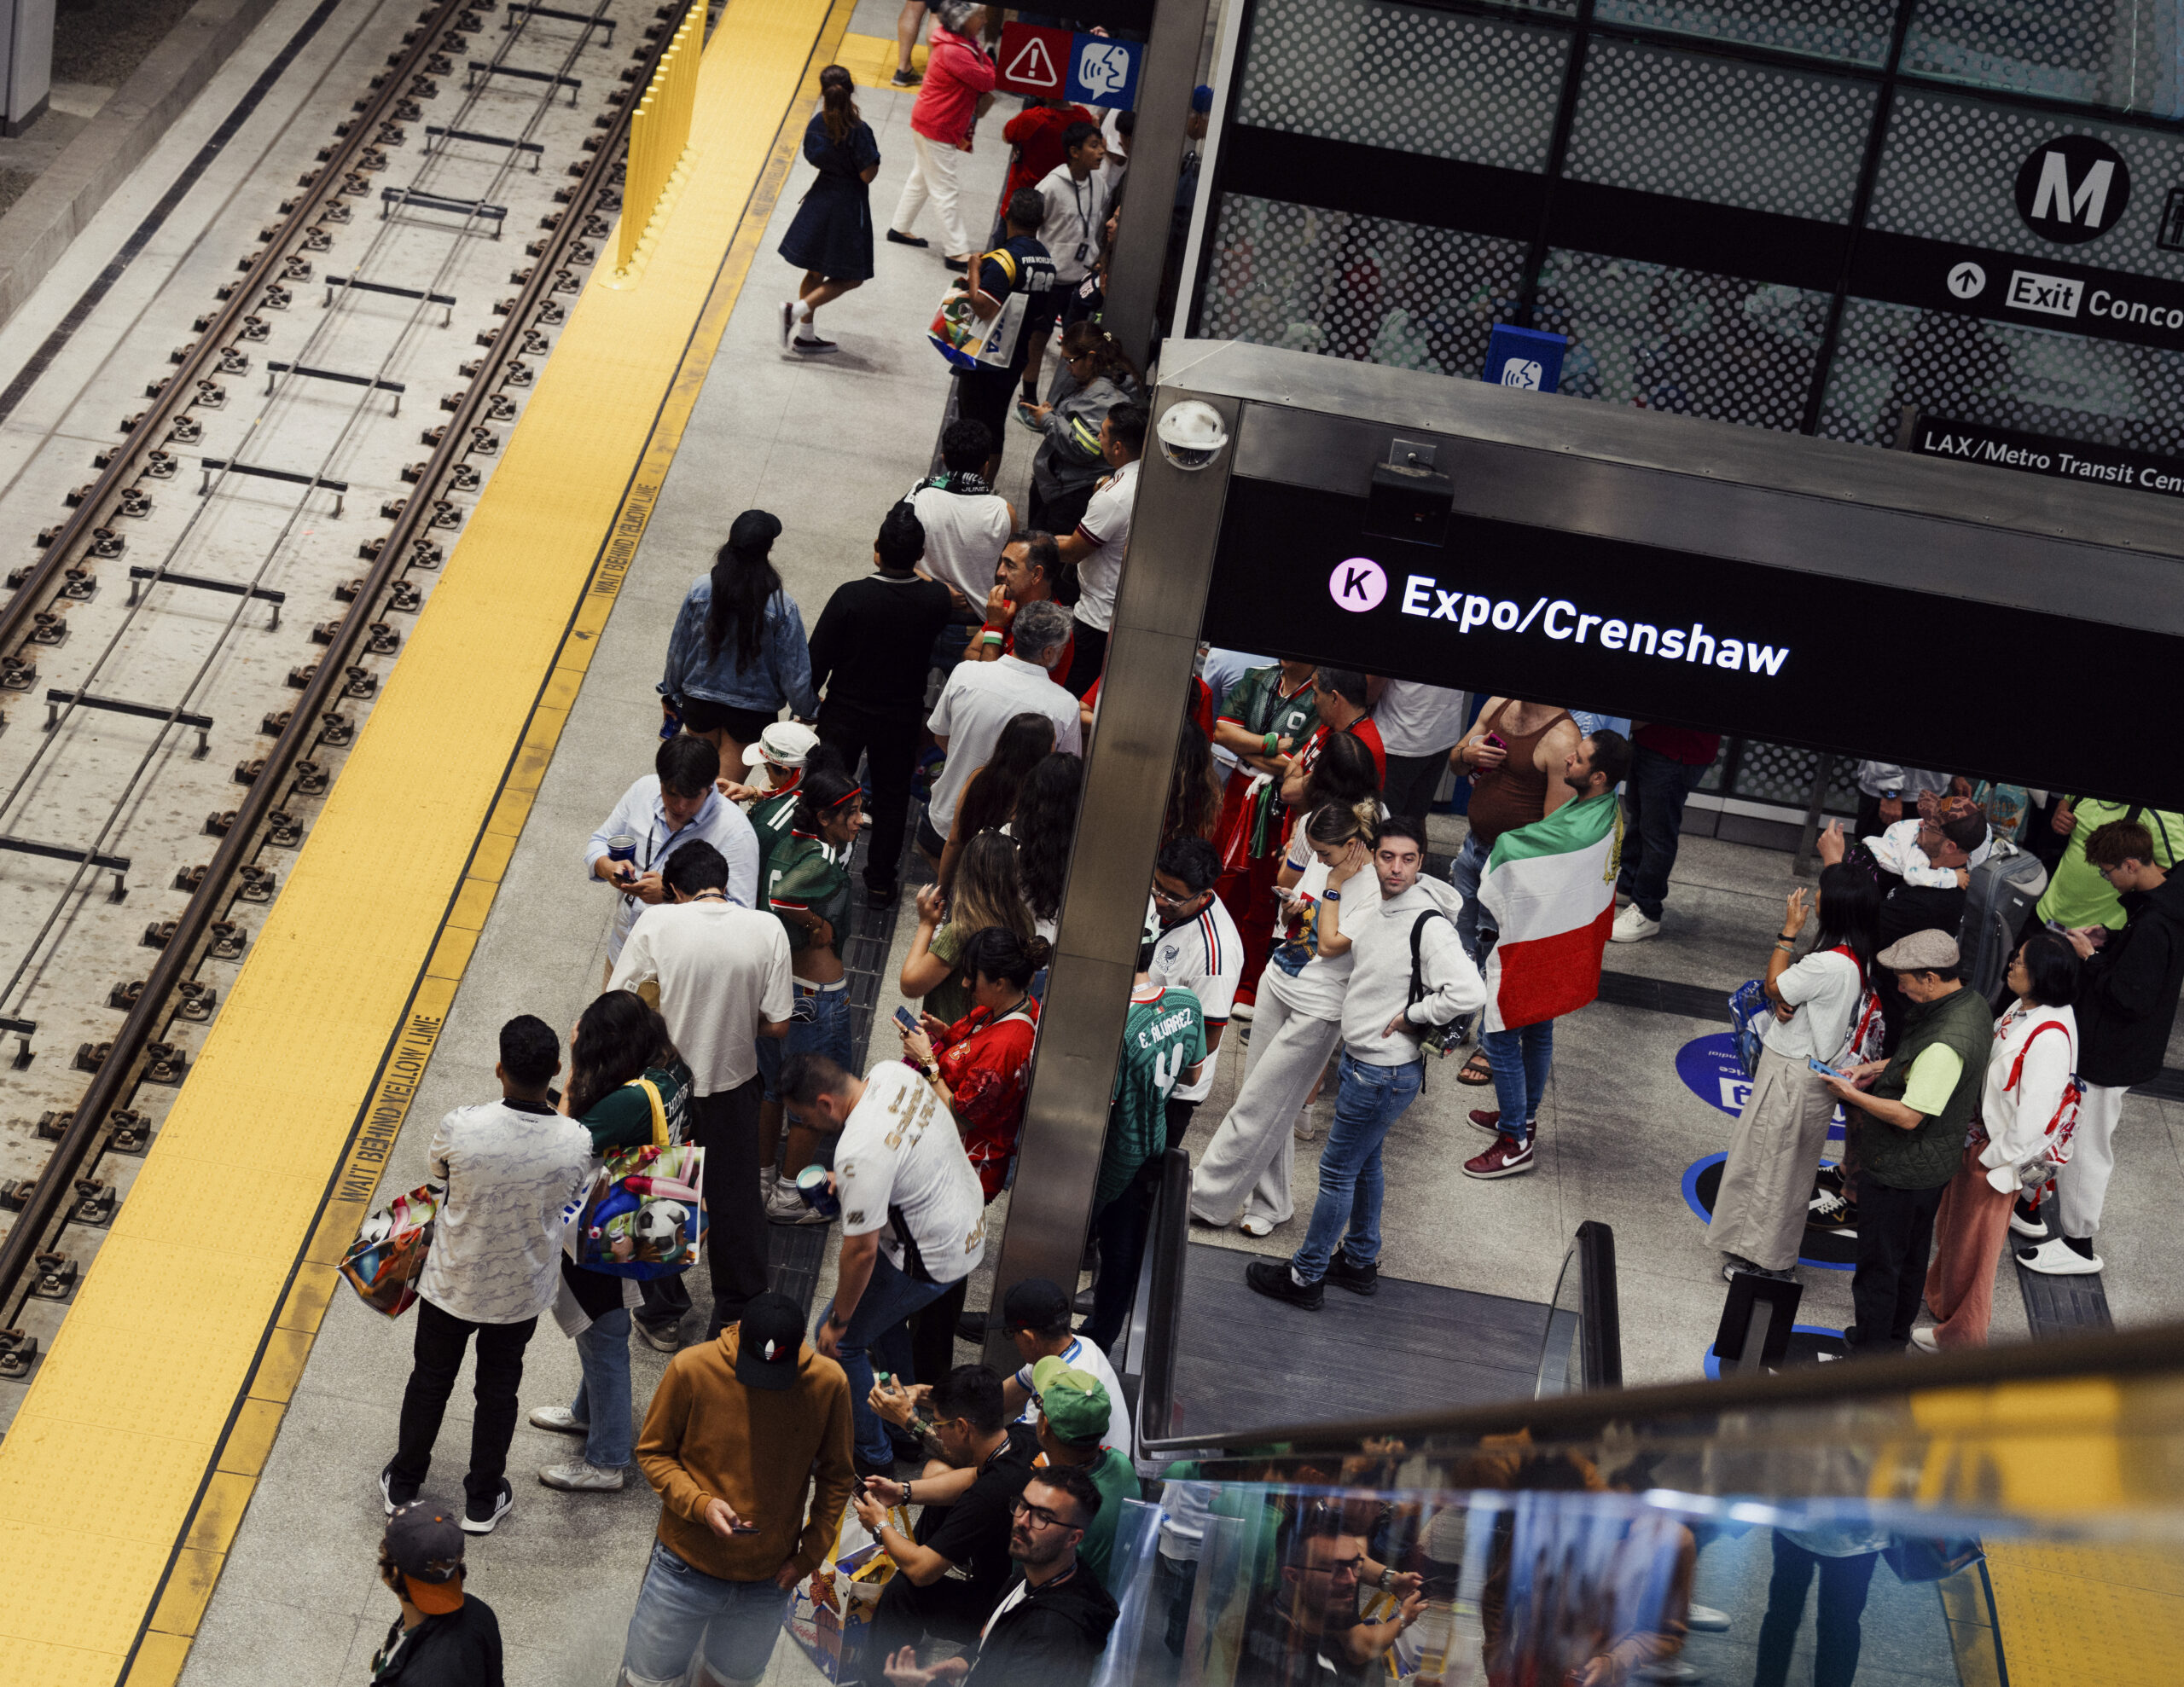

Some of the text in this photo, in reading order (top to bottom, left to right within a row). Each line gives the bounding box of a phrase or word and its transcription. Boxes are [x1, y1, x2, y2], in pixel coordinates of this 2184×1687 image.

[1021, 256, 1036, 264] FIFA
[2013, 276, 2074, 310] Exit
[1924, 431, 2051, 469] LAX/Metro
[2058, 453, 2134, 484] Transit
[594, 484, 658, 594] WAIT BEHIND YELLOW LINE
[1343, 566, 1789, 675] K Expo/Crenshaw
[1138, 1031, 1152, 1049] E.
[339, 1014, 441, 1203] WAIT BEHIND YELLOW LINE
